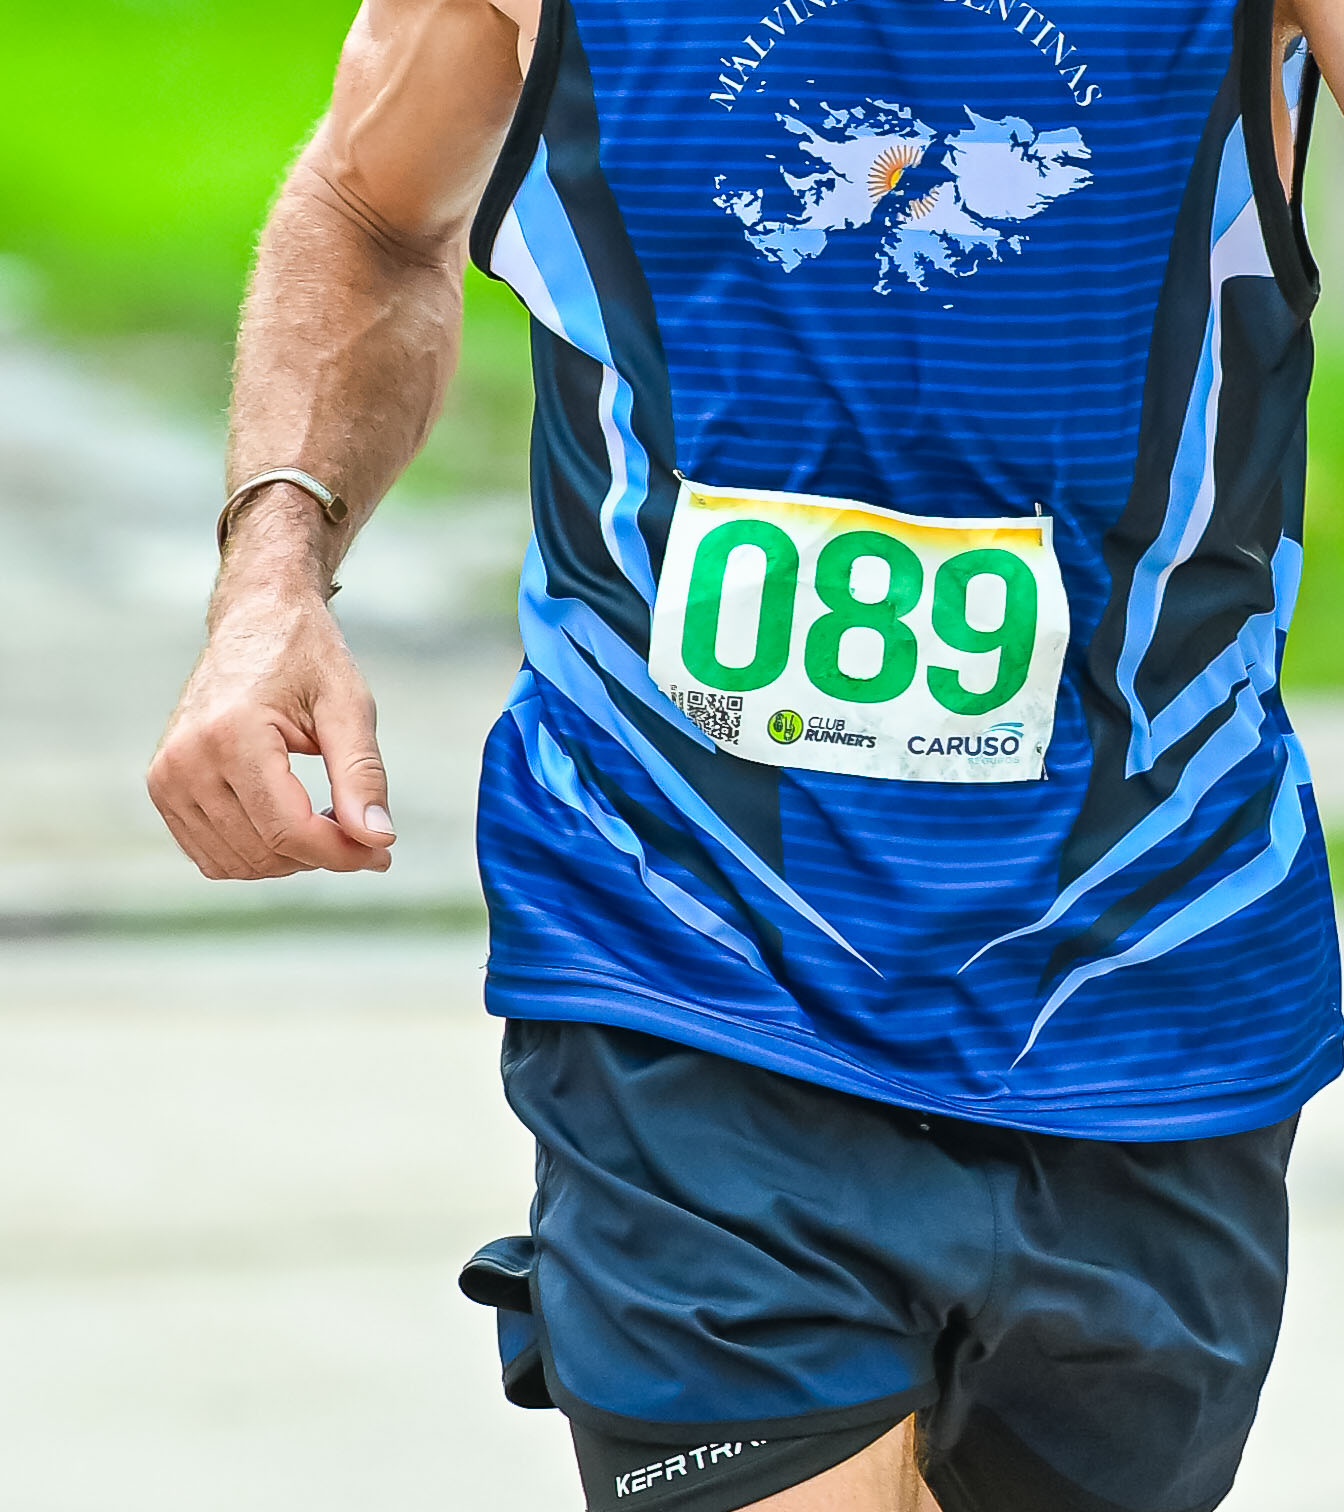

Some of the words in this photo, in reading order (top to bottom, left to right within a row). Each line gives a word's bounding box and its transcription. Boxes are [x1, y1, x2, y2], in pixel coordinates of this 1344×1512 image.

[681, 519, 1038, 716] 089
[807, 716, 846, 731] CLUB
[907, 735, 1020, 756] CARUSO
